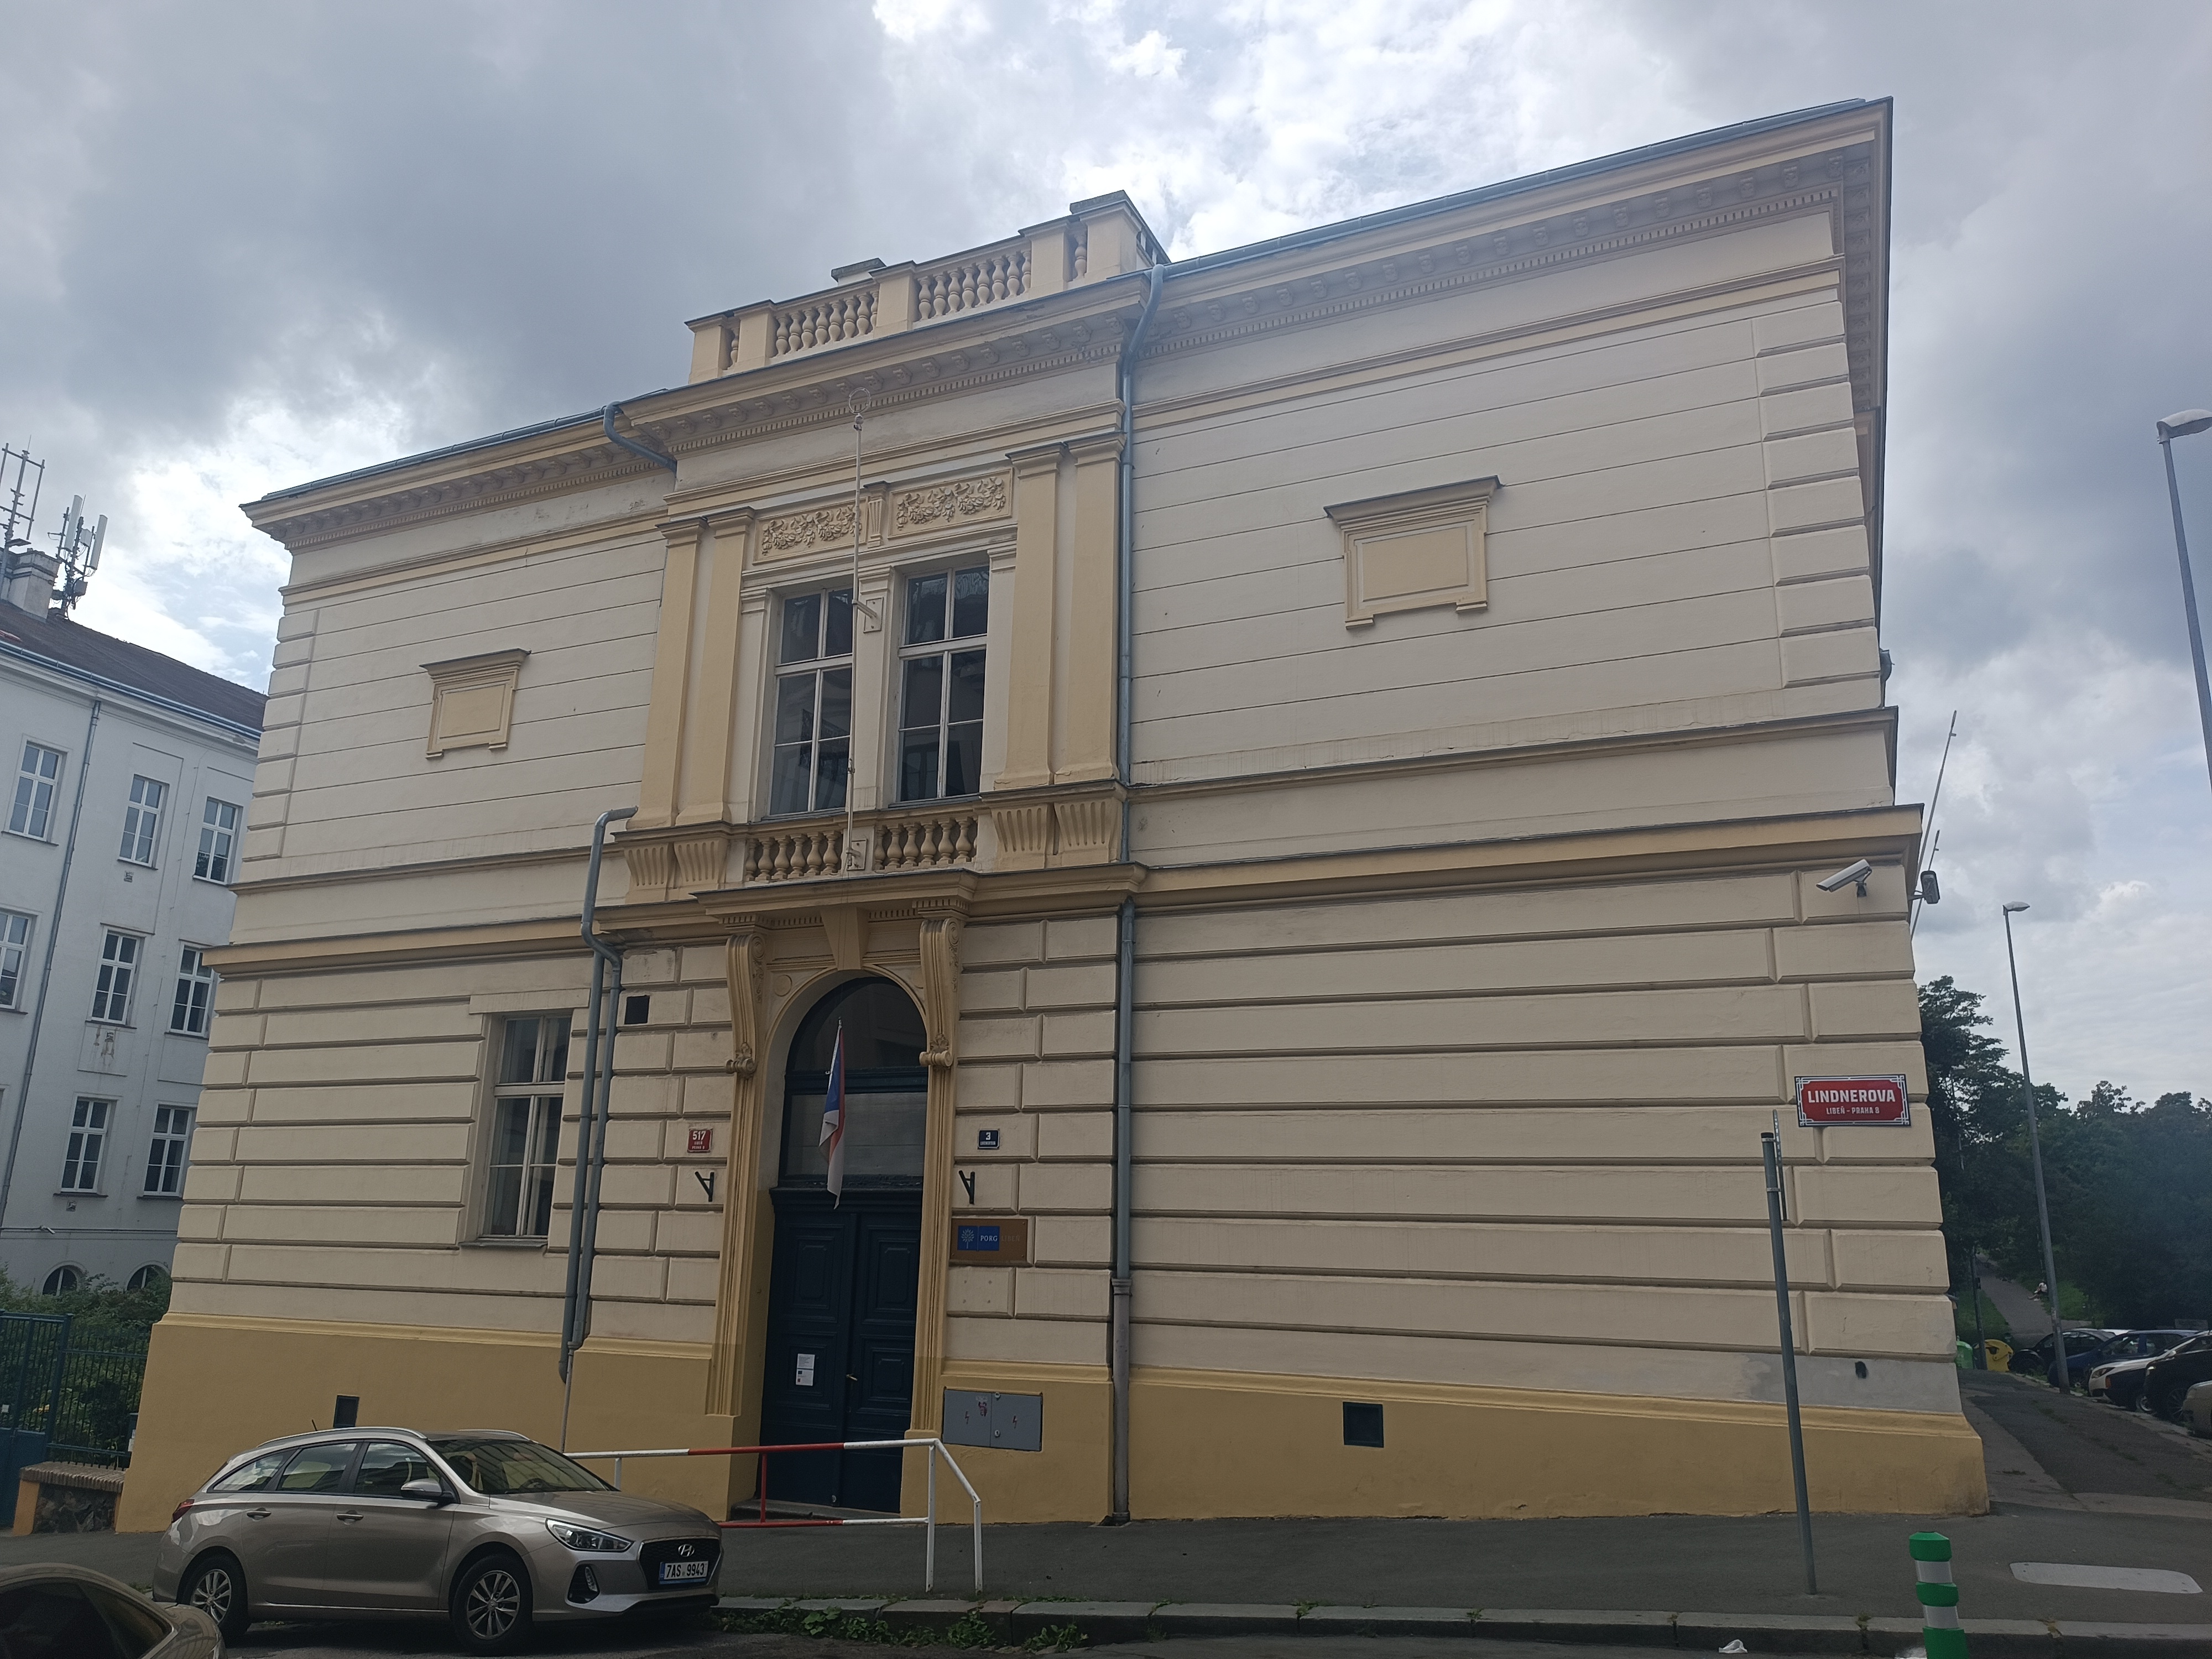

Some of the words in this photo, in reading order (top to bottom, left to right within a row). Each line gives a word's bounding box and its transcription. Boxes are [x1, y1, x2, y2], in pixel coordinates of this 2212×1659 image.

[1807, 1089, 1896, 1103] LINDNEROVA
[1826, 1105, 1845, 1115] LIBEŇ
[692, 1130, 706, 1140] 517
[985, 1131, 991, 1140] 3
[666, 1564, 681, 1578] 7AS
[686, 1563, 705, 1577] 9943
